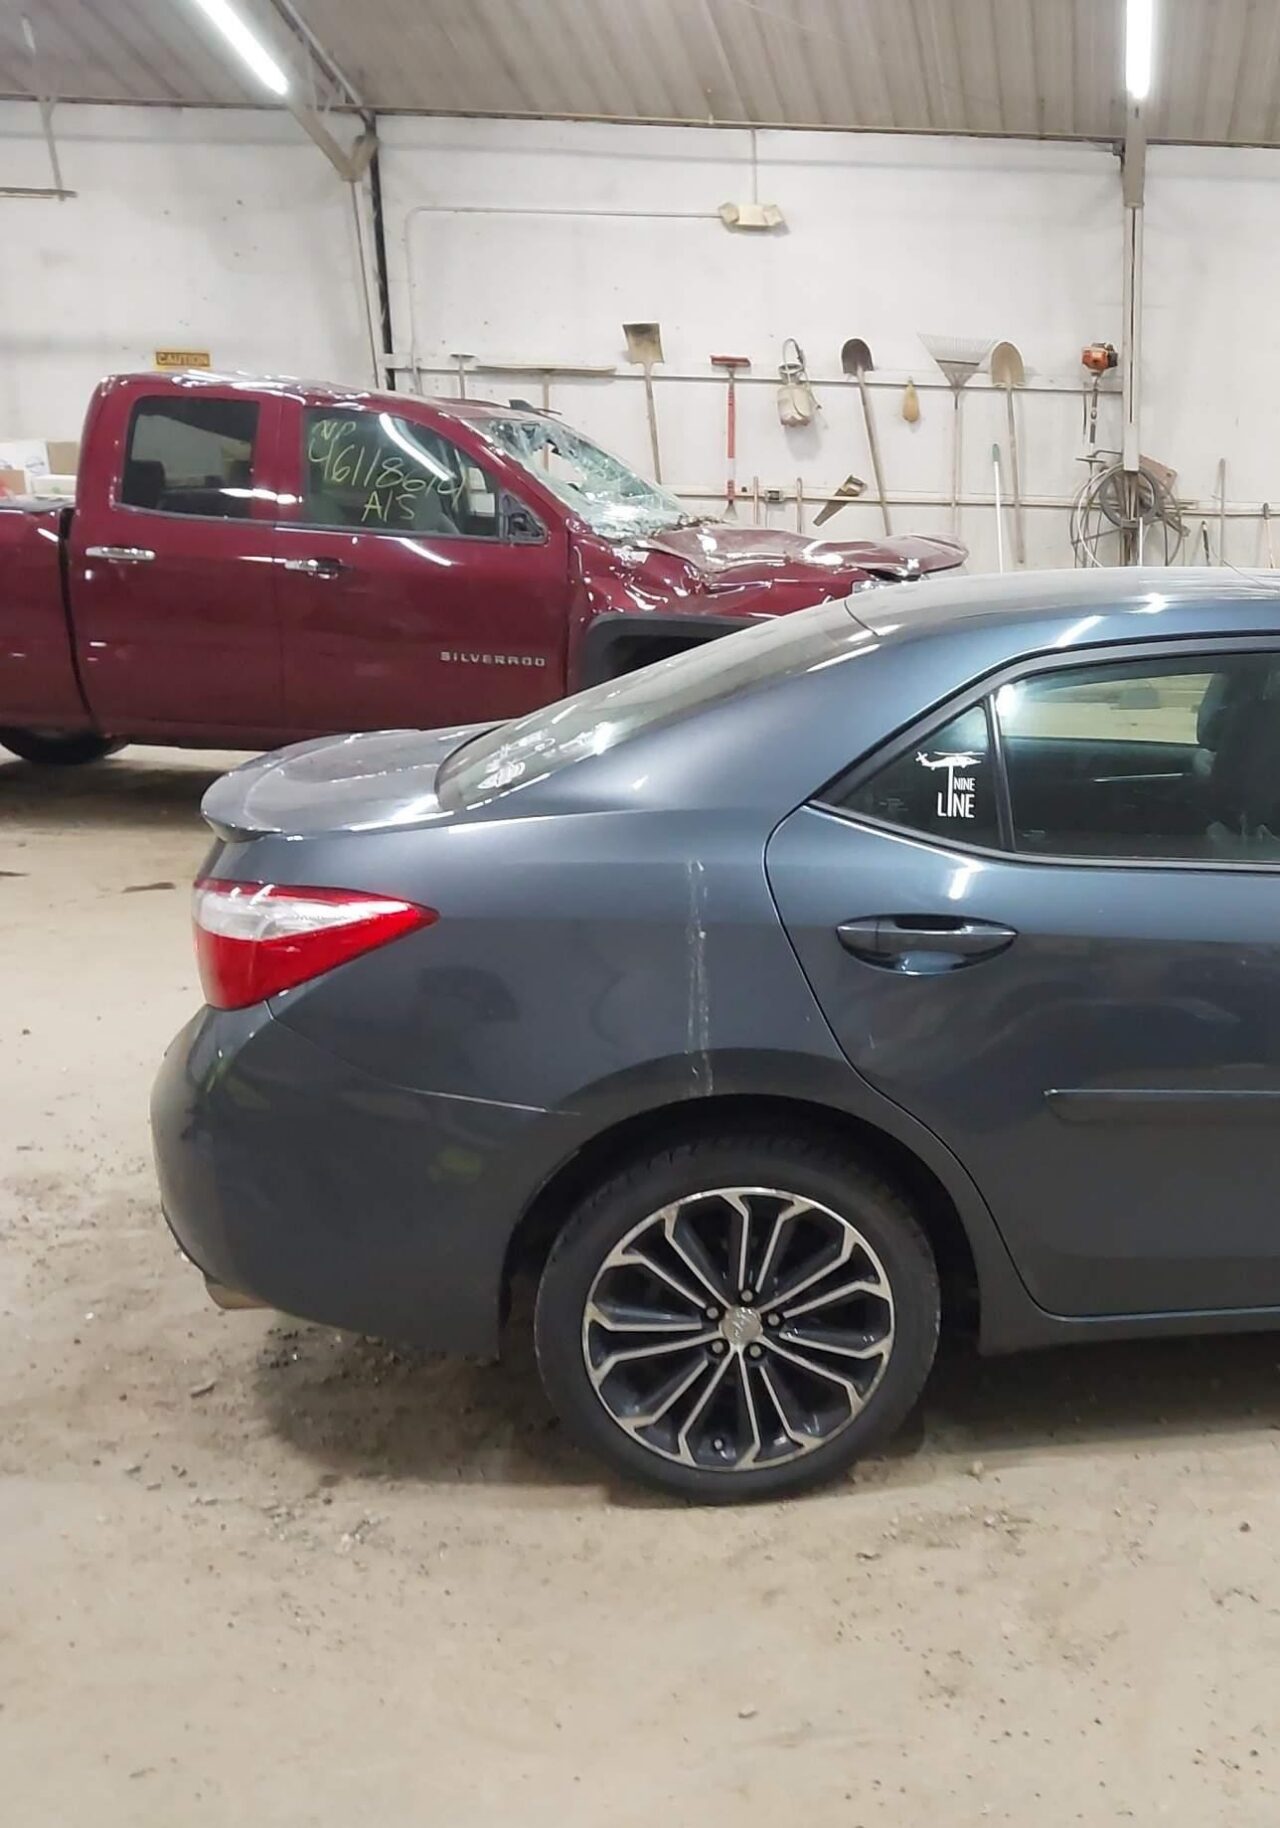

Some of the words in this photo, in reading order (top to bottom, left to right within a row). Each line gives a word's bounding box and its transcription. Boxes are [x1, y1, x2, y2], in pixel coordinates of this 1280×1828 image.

[440, 651, 546, 667] SILVERADO
[953, 776, 976, 792] NINE
[937, 791, 976, 819] LINE
